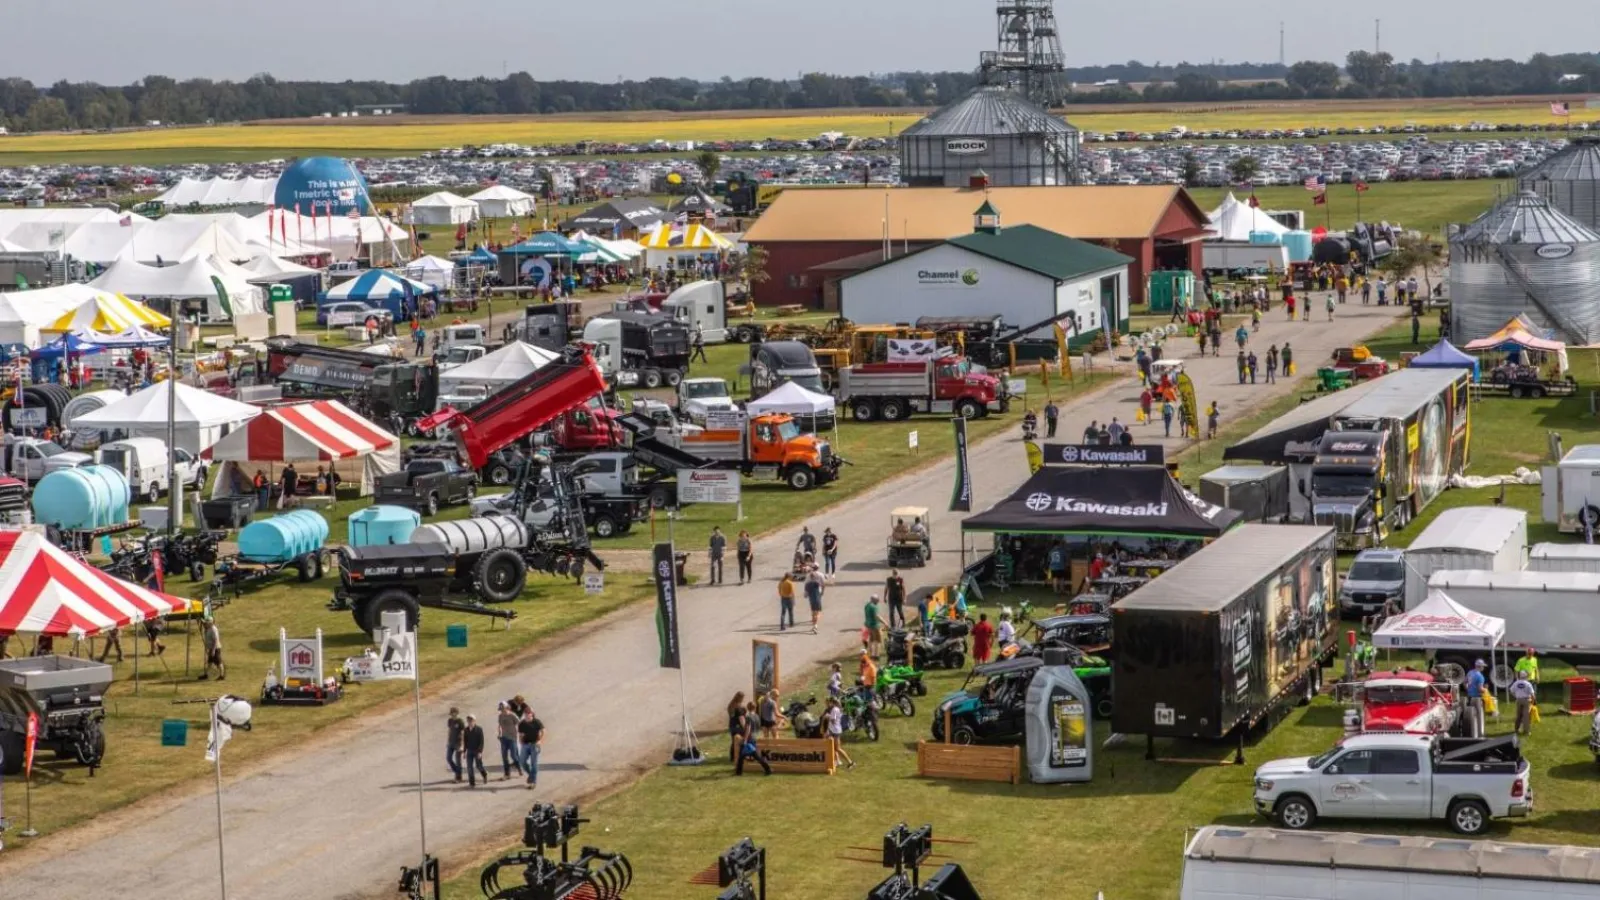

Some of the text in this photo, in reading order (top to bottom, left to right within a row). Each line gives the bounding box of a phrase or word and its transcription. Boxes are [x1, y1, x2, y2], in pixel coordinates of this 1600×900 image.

[948, 142, 986, 150] BROCK
[308, 180, 328, 189] This
[299, 189, 331, 199] metric
[918, 269, 959, 279] Channel
[1080, 449, 1147, 462] Kawasaki
[1055, 497, 1169, 517] Kawasaki
[760, 749, 826, 762] Kawasaki
